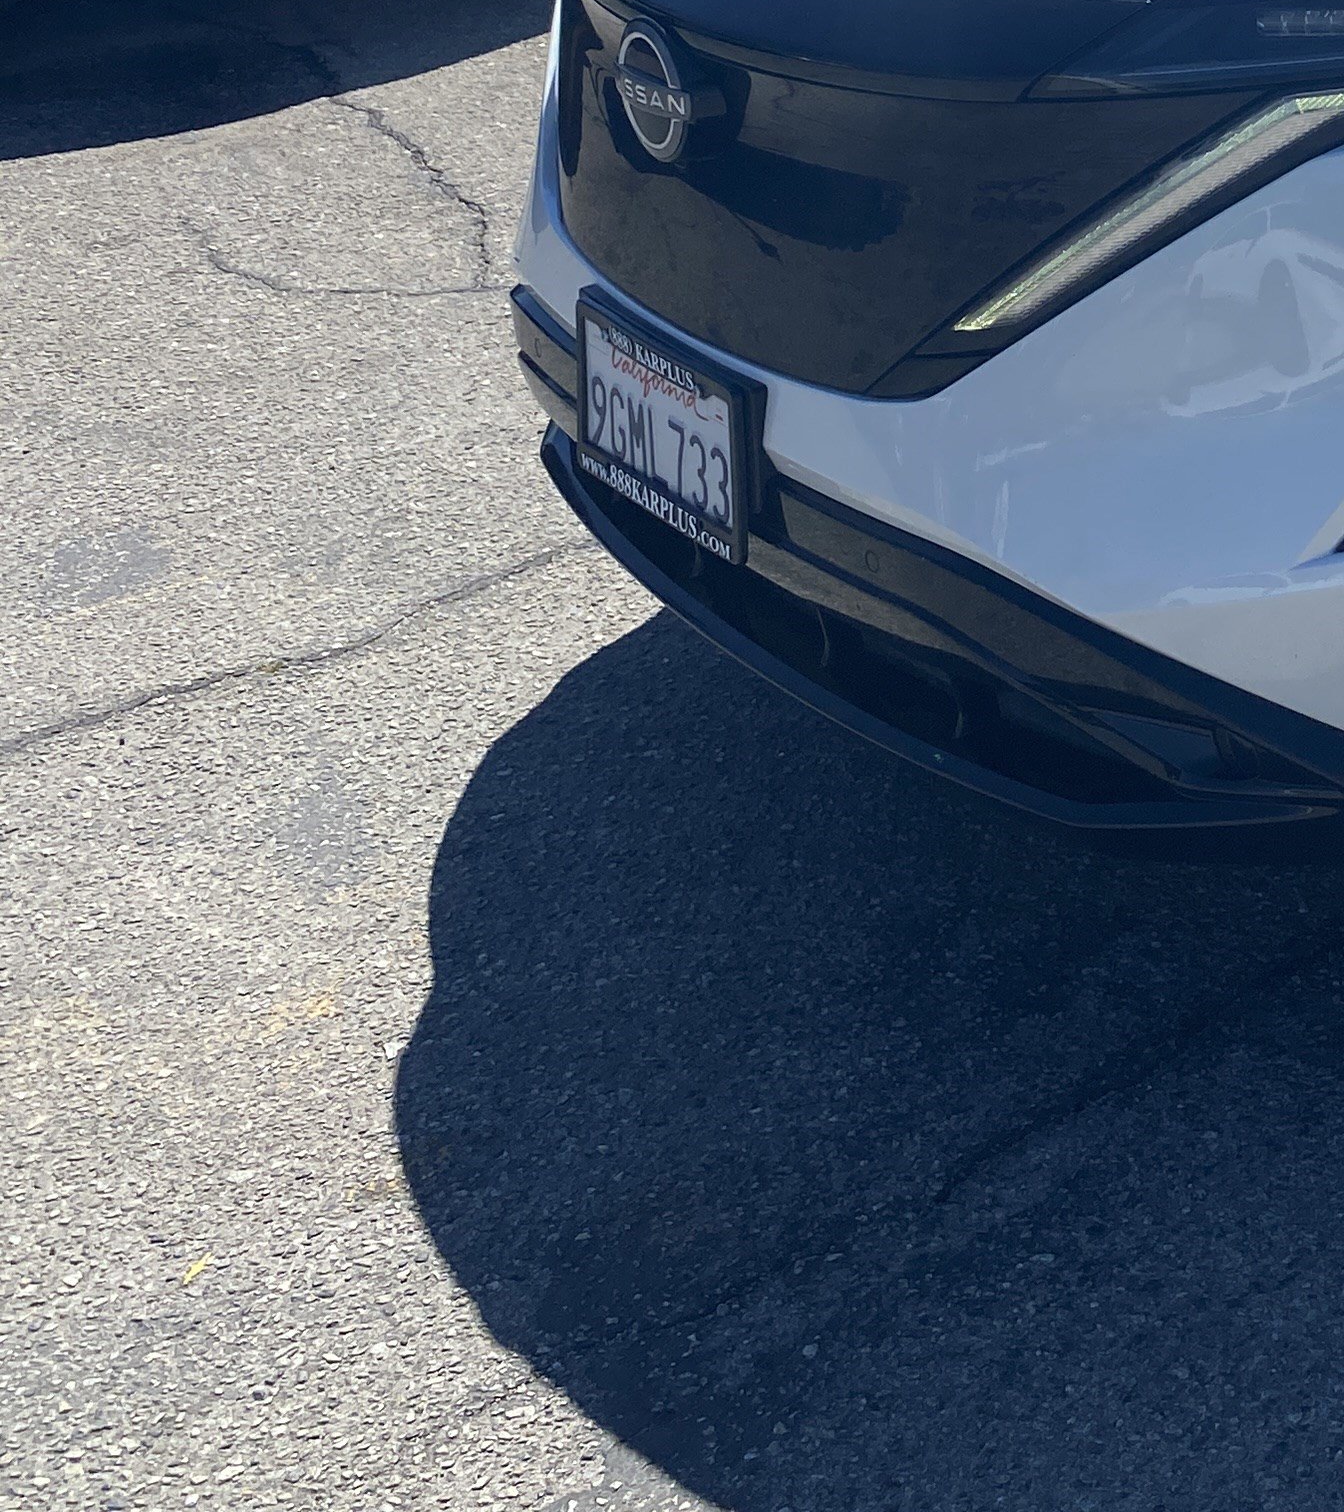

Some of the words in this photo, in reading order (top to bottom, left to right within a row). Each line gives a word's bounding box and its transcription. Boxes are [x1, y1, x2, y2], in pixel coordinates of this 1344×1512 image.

[623, 78, 685, 116] SSAN
[608, 325, 633, 355] (888)
[634, 342, 694, 390] KARPLUS
[591, 375, 730, 524] 9GML733
